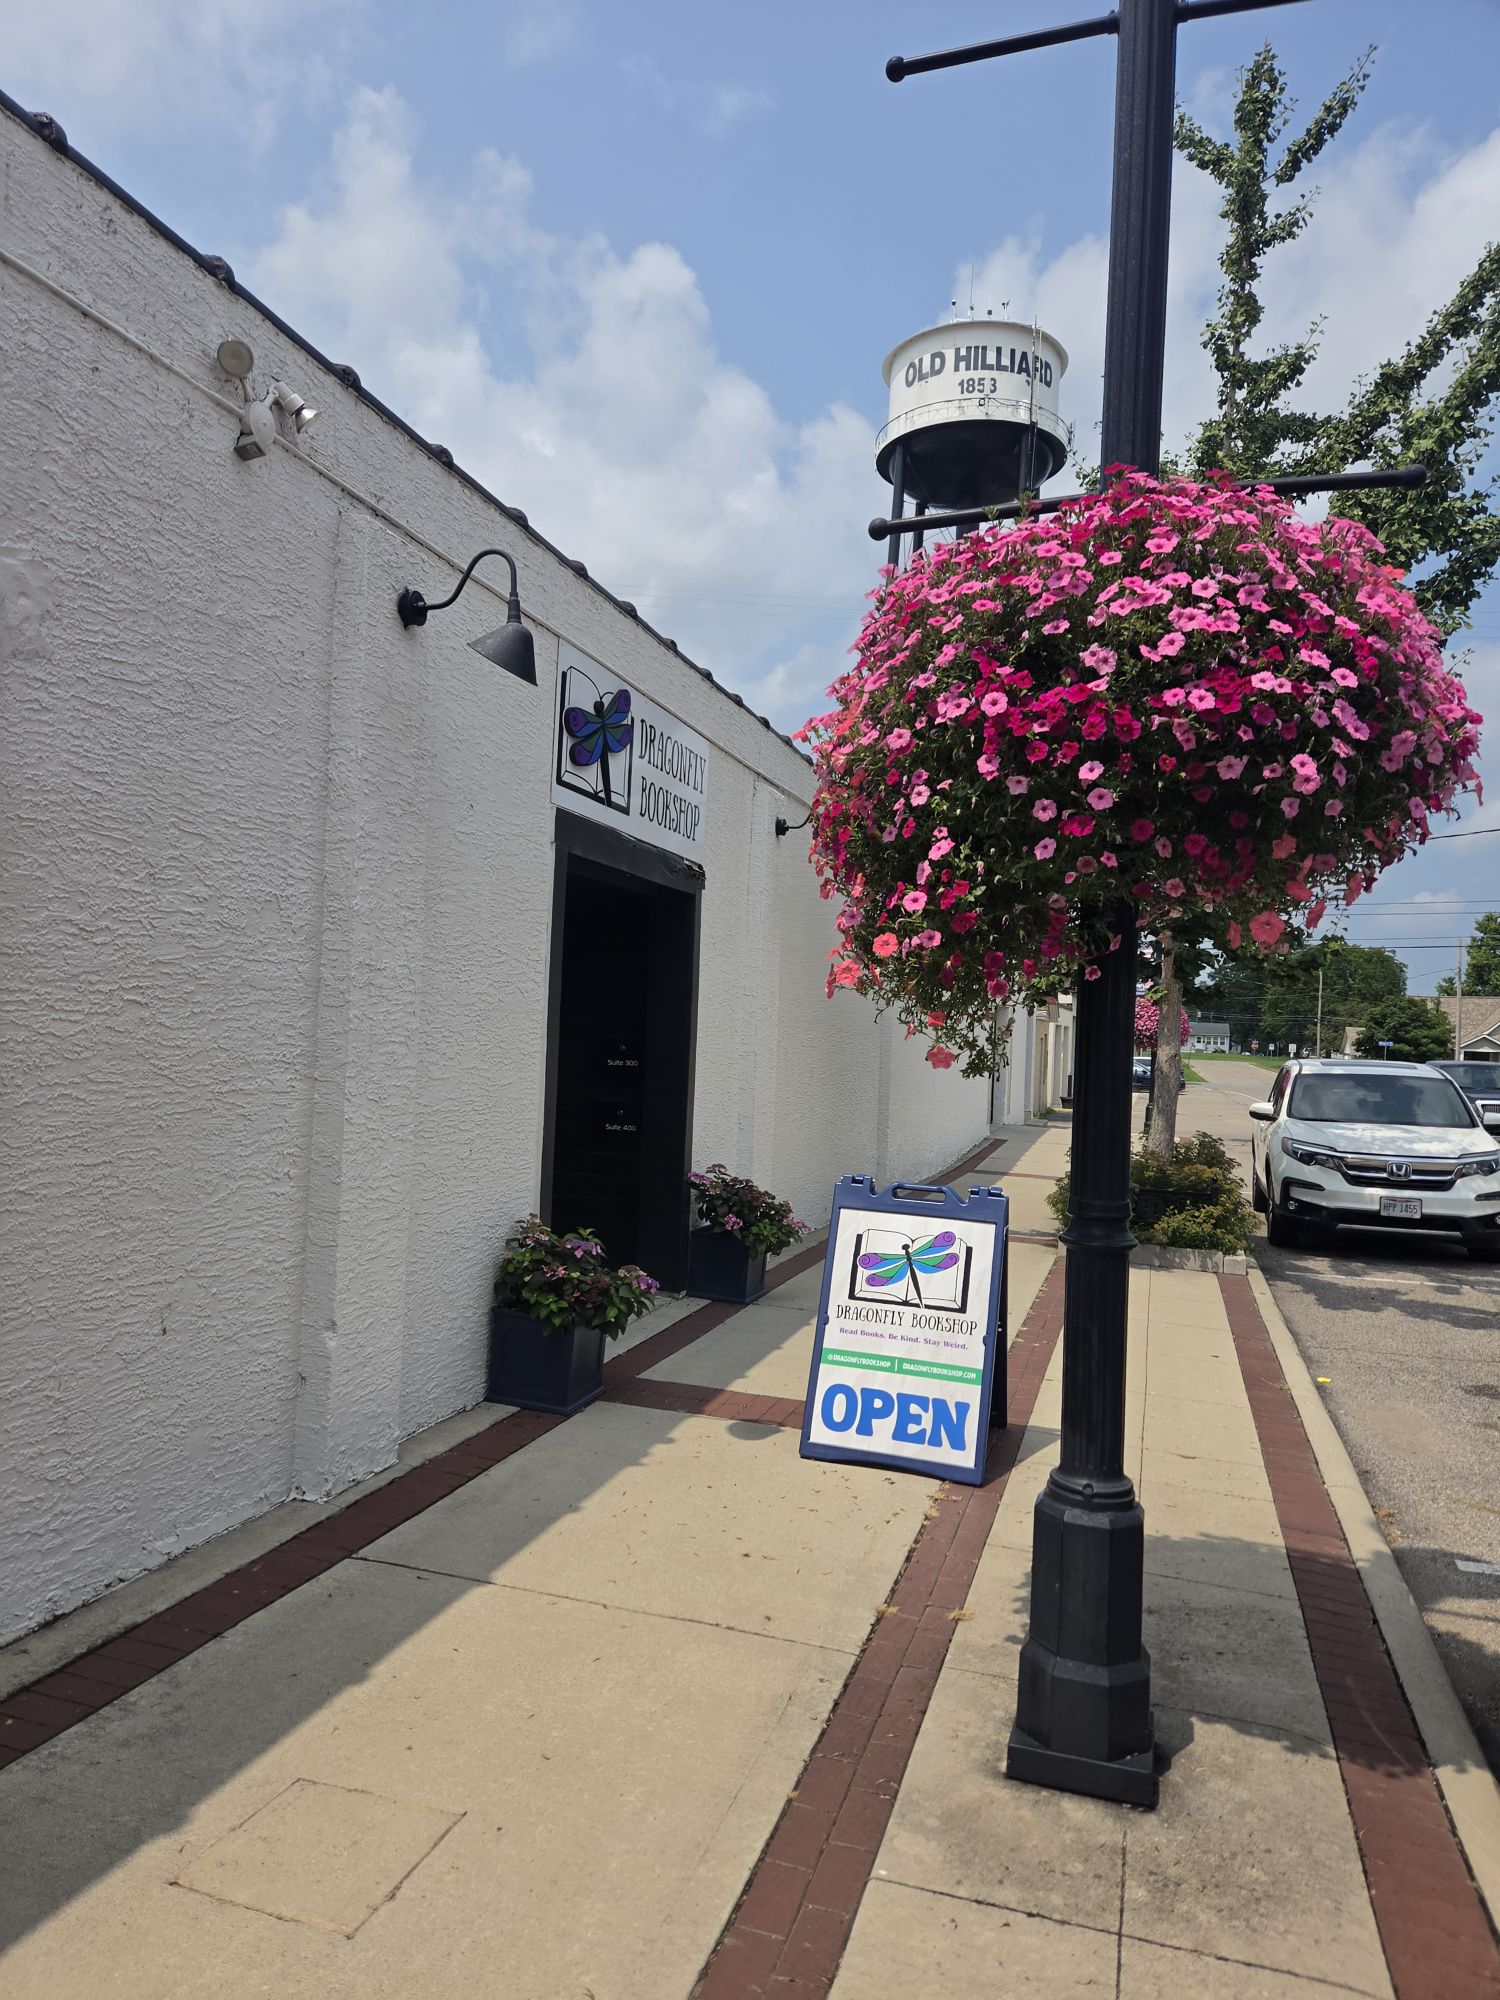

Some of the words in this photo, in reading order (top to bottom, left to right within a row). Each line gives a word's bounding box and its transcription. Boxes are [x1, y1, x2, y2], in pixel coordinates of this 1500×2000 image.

[905, 350, 946, 388] OLD
[954, 345, 1053, 389] HILLIARD
[958, 377, 997, 395] 1853
[638, 718, 707, 795] DRAGONFLY
[639, 776, 701, 842] BOOKSHOP
[607, 1059, 624, 1067] Suite
[624, 1059, 639, 1067] 300
[605, 1123, 622, 1131] Suite
[622, 1124, 637, 1132] 400
[836, 1304, 906, 1327] DRAGONFLY
[910, 1312, 978, 1337] BOOKSHOP
[839, 1327, 859, 1336] Read
[860, 1330, 887, 1340] Books.
[888, 1333, 899, 1341] Be
[900, 1335, 922, 1345] Kind.
[923, 1338, 941, 1348] Stay
[943, 1340, 969, 1351] Weird.
[827, 1353, 892, 1369] @DRAGONFLYBOOKSHOP
[902, 1362, 977, 1380] DRAGONFLYBOOKSHOP.COM
[820, 1383, 971, 1452] OPEN
